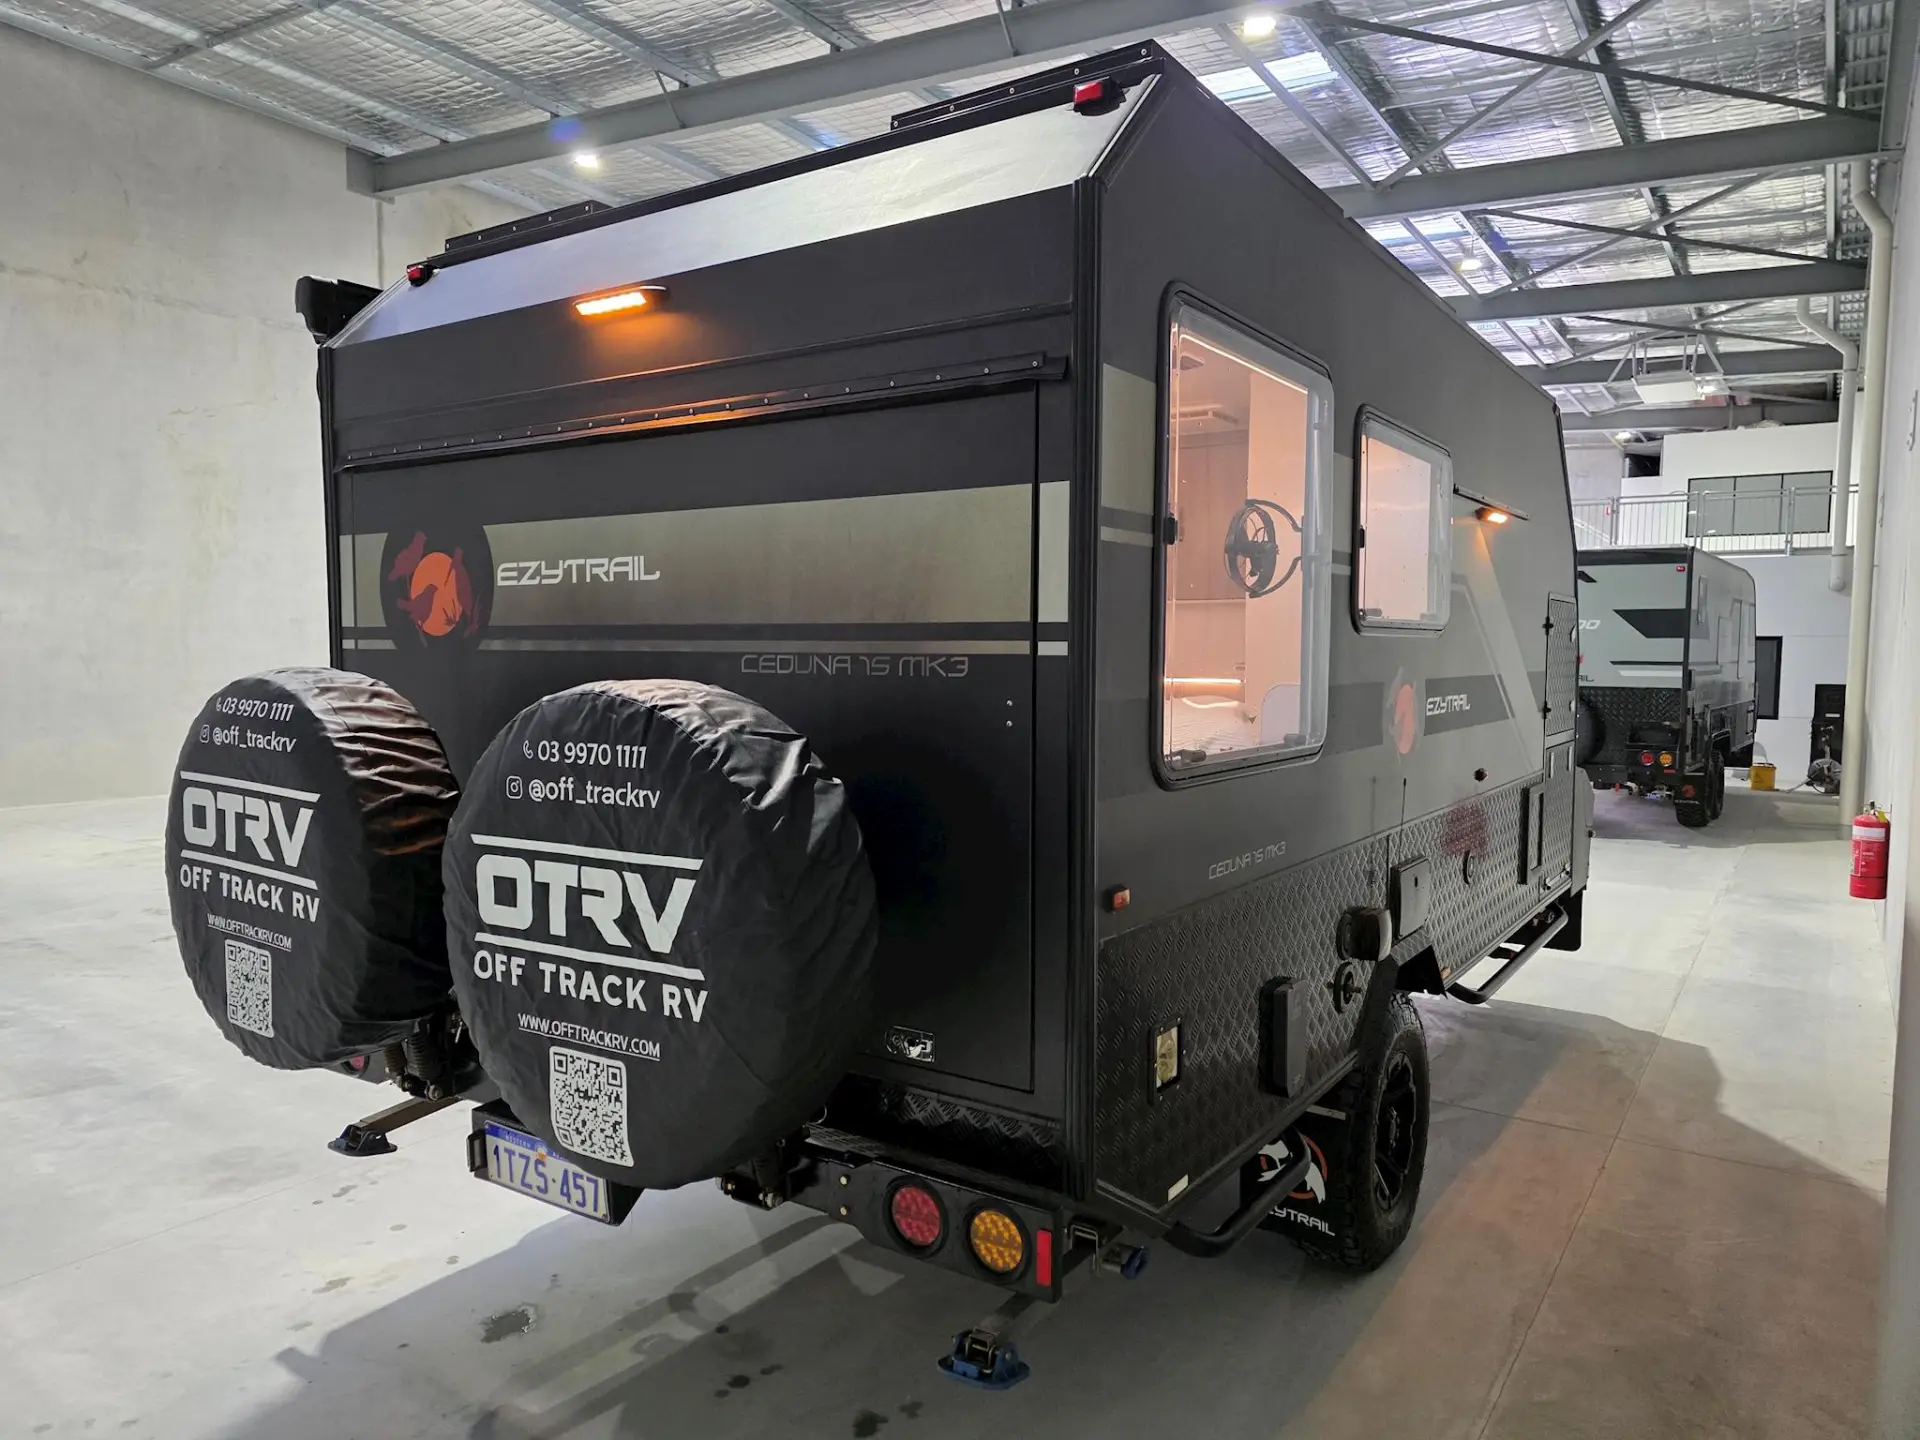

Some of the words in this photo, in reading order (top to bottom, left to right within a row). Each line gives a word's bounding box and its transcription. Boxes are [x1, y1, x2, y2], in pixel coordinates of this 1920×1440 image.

[496, 555, 661, 586] EZYTRAIL
[741, 655, 851, 675] CEDUNA
[898, 656, 969, 678] MK3
[222, 697, 237, 714] 03
[237, 699, 269, 718] 9970
[269, 702, 295, 721] 1111
[213, 725, 297, 753] @off_trackrv
[537, 739, 560, 762] 03
[563, 742, 612, 766] 9970
[616, 744, 647, 769] 1111
[528, 776, 661, 808] @off_trackrv
[183, 786, 314, 867] OTRV
[1208, 852, 1252, 880] CEDUNA
[180, 864, 212, 892] OFF
[219, 872, 284, 913] TRACK
[292, 891, 320, 923] RV
[475, 854, 696, 954] OTRV
[207, 913, 292, 950] WWW.OFFTRACKRV.COM
[474, 950, 526, 986] OFF
[538, 961, 647, 1012] TRACK
[662, 983, 709, 1024] RV
[518, 1012, 661, 1058] WWW.OFFTRACKRV.COM
[1269, 1204, 1336, 1237] YTRAIL
